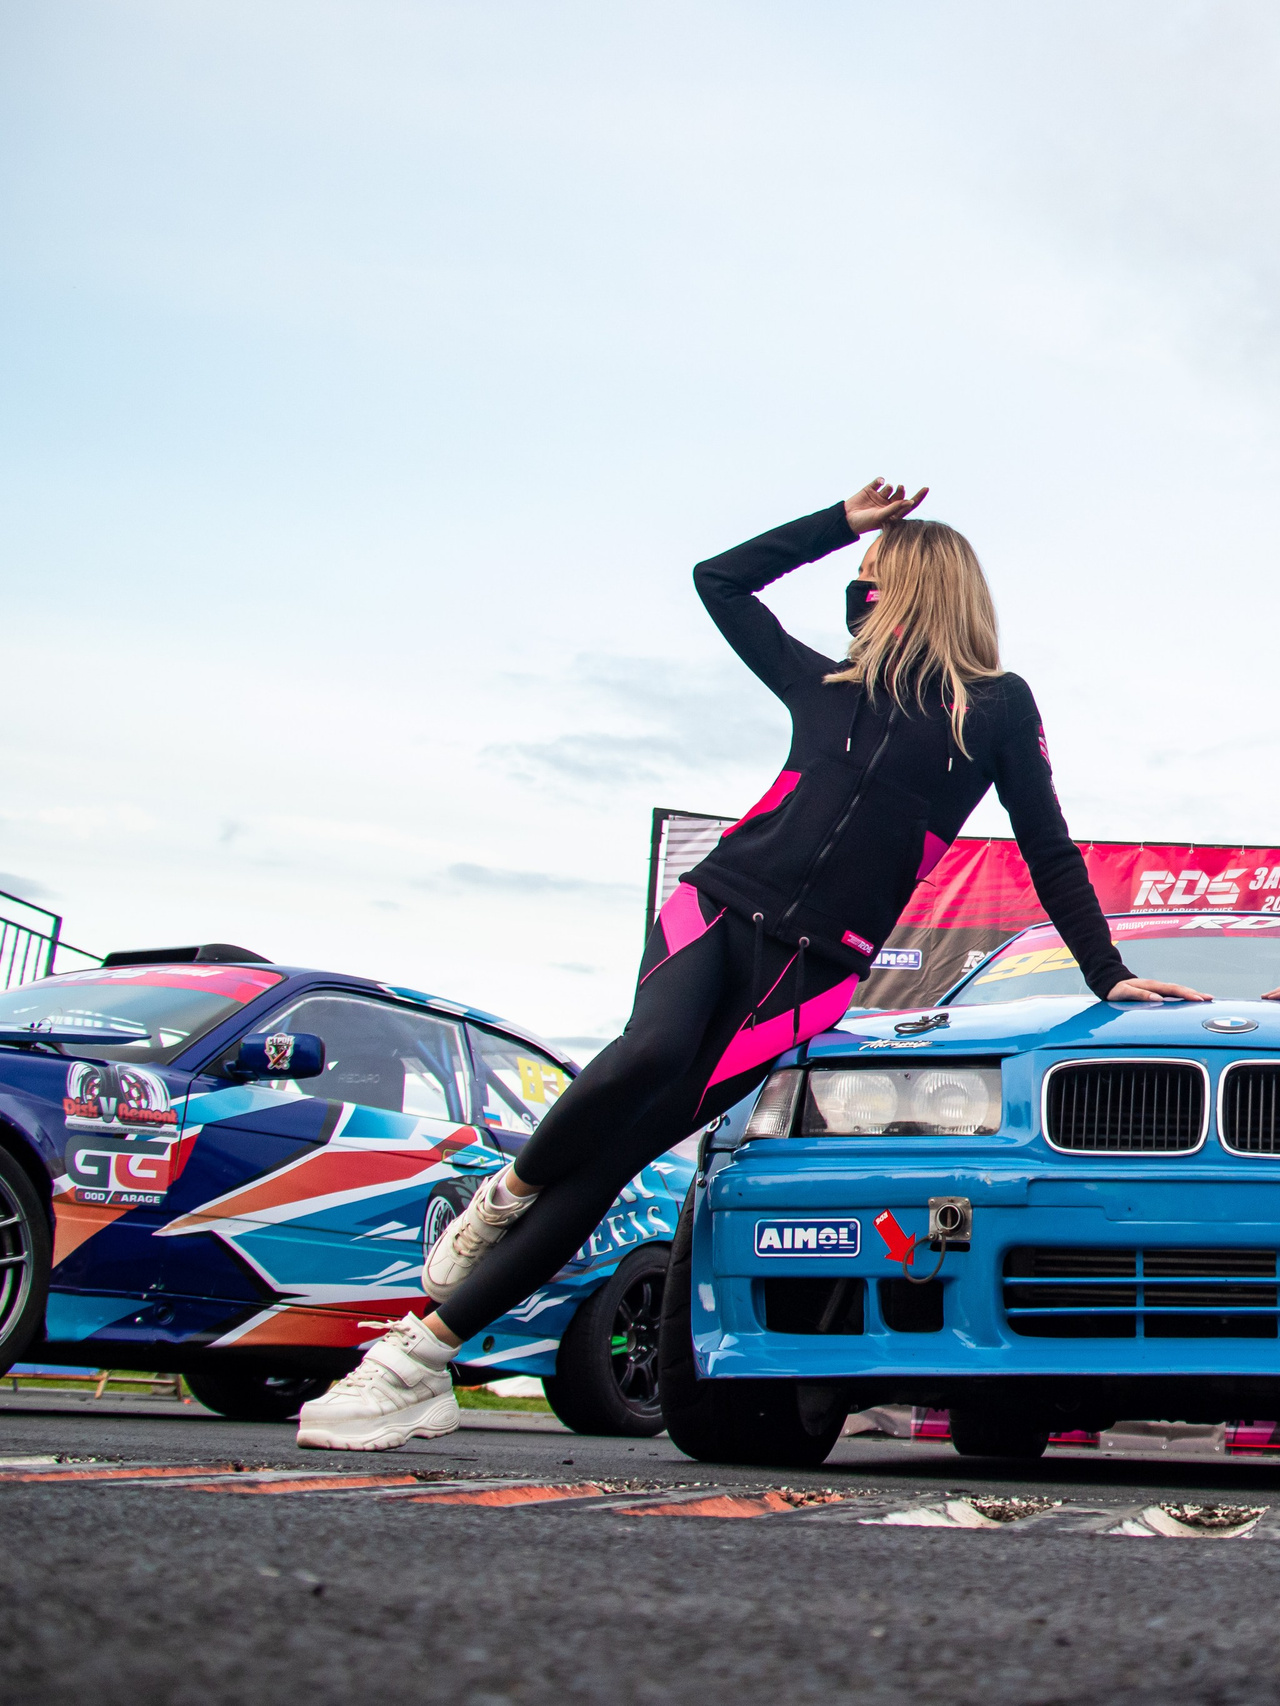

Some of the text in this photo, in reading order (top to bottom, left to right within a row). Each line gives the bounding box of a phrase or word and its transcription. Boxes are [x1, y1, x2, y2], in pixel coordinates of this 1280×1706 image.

[1133, 868, 1247, 906] RDS
[873, 953, 919, 966] IMOL
[517, 1057, 567, 1104] 87
[63, 1097, 99, 1118] Disk
[118, 1103, 178, 1124] Remont
[576, 1206, 672, 1260] EELS
[758, 1228, 855, 1249] AIMOL
